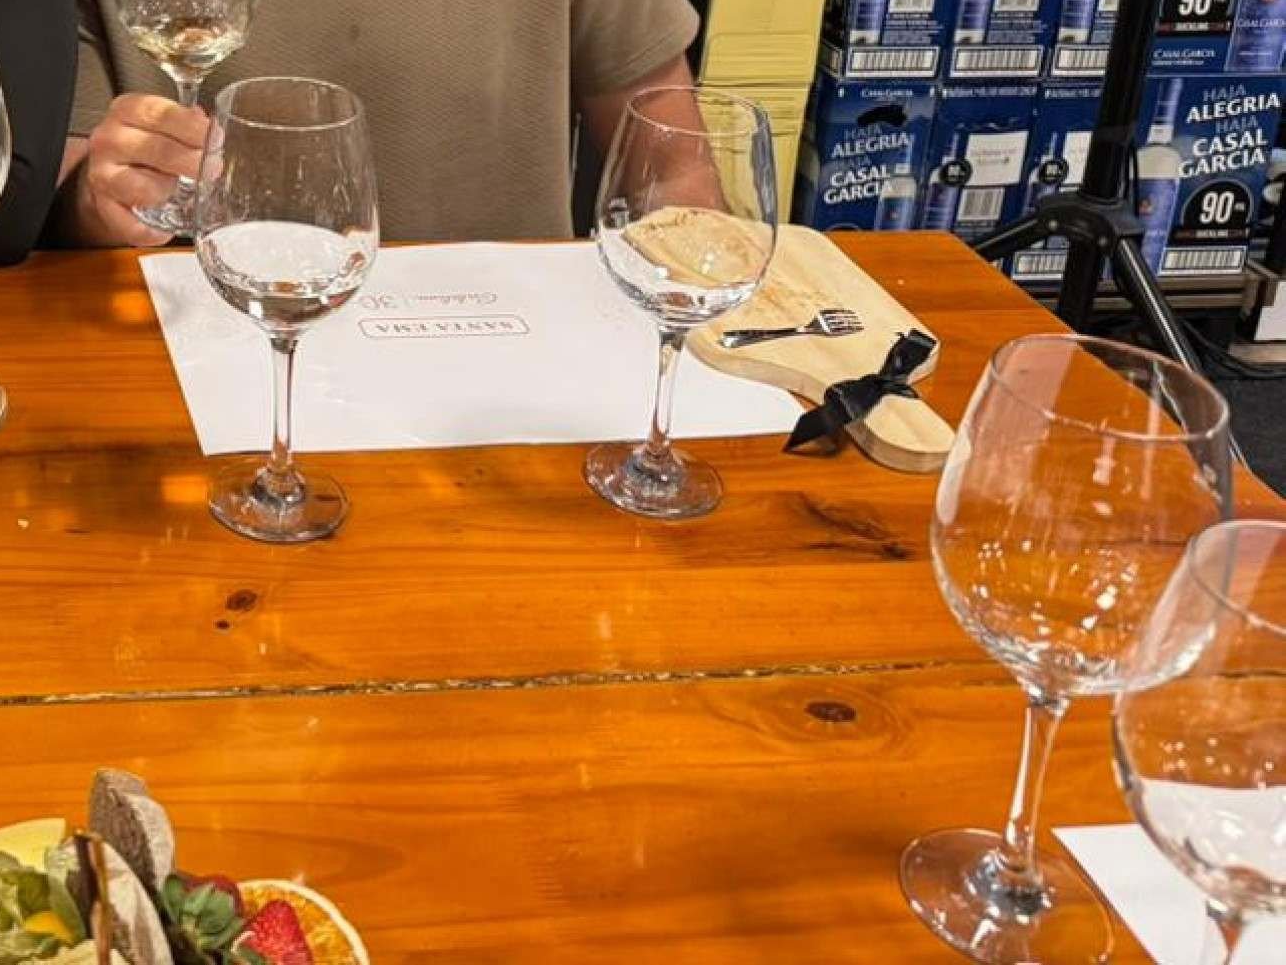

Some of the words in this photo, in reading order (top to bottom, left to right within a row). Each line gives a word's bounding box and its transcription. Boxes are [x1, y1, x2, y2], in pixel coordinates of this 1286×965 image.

[1185, 92, 1282, 125] ALEGRIA
[832, 132, 910, 159] ALEGRIA
[1192, 128, 1269, 158] CASAL
[829, 163, 891, 188] CASAL
[1177, 147, 1268, 179] GARCIA
[823, 180, 893, 205] GARCIA
[1199, 190, 1235, 225] 90
[374, 322, 430, 335] EMA
[434, 321, 514, 335] SANTA
